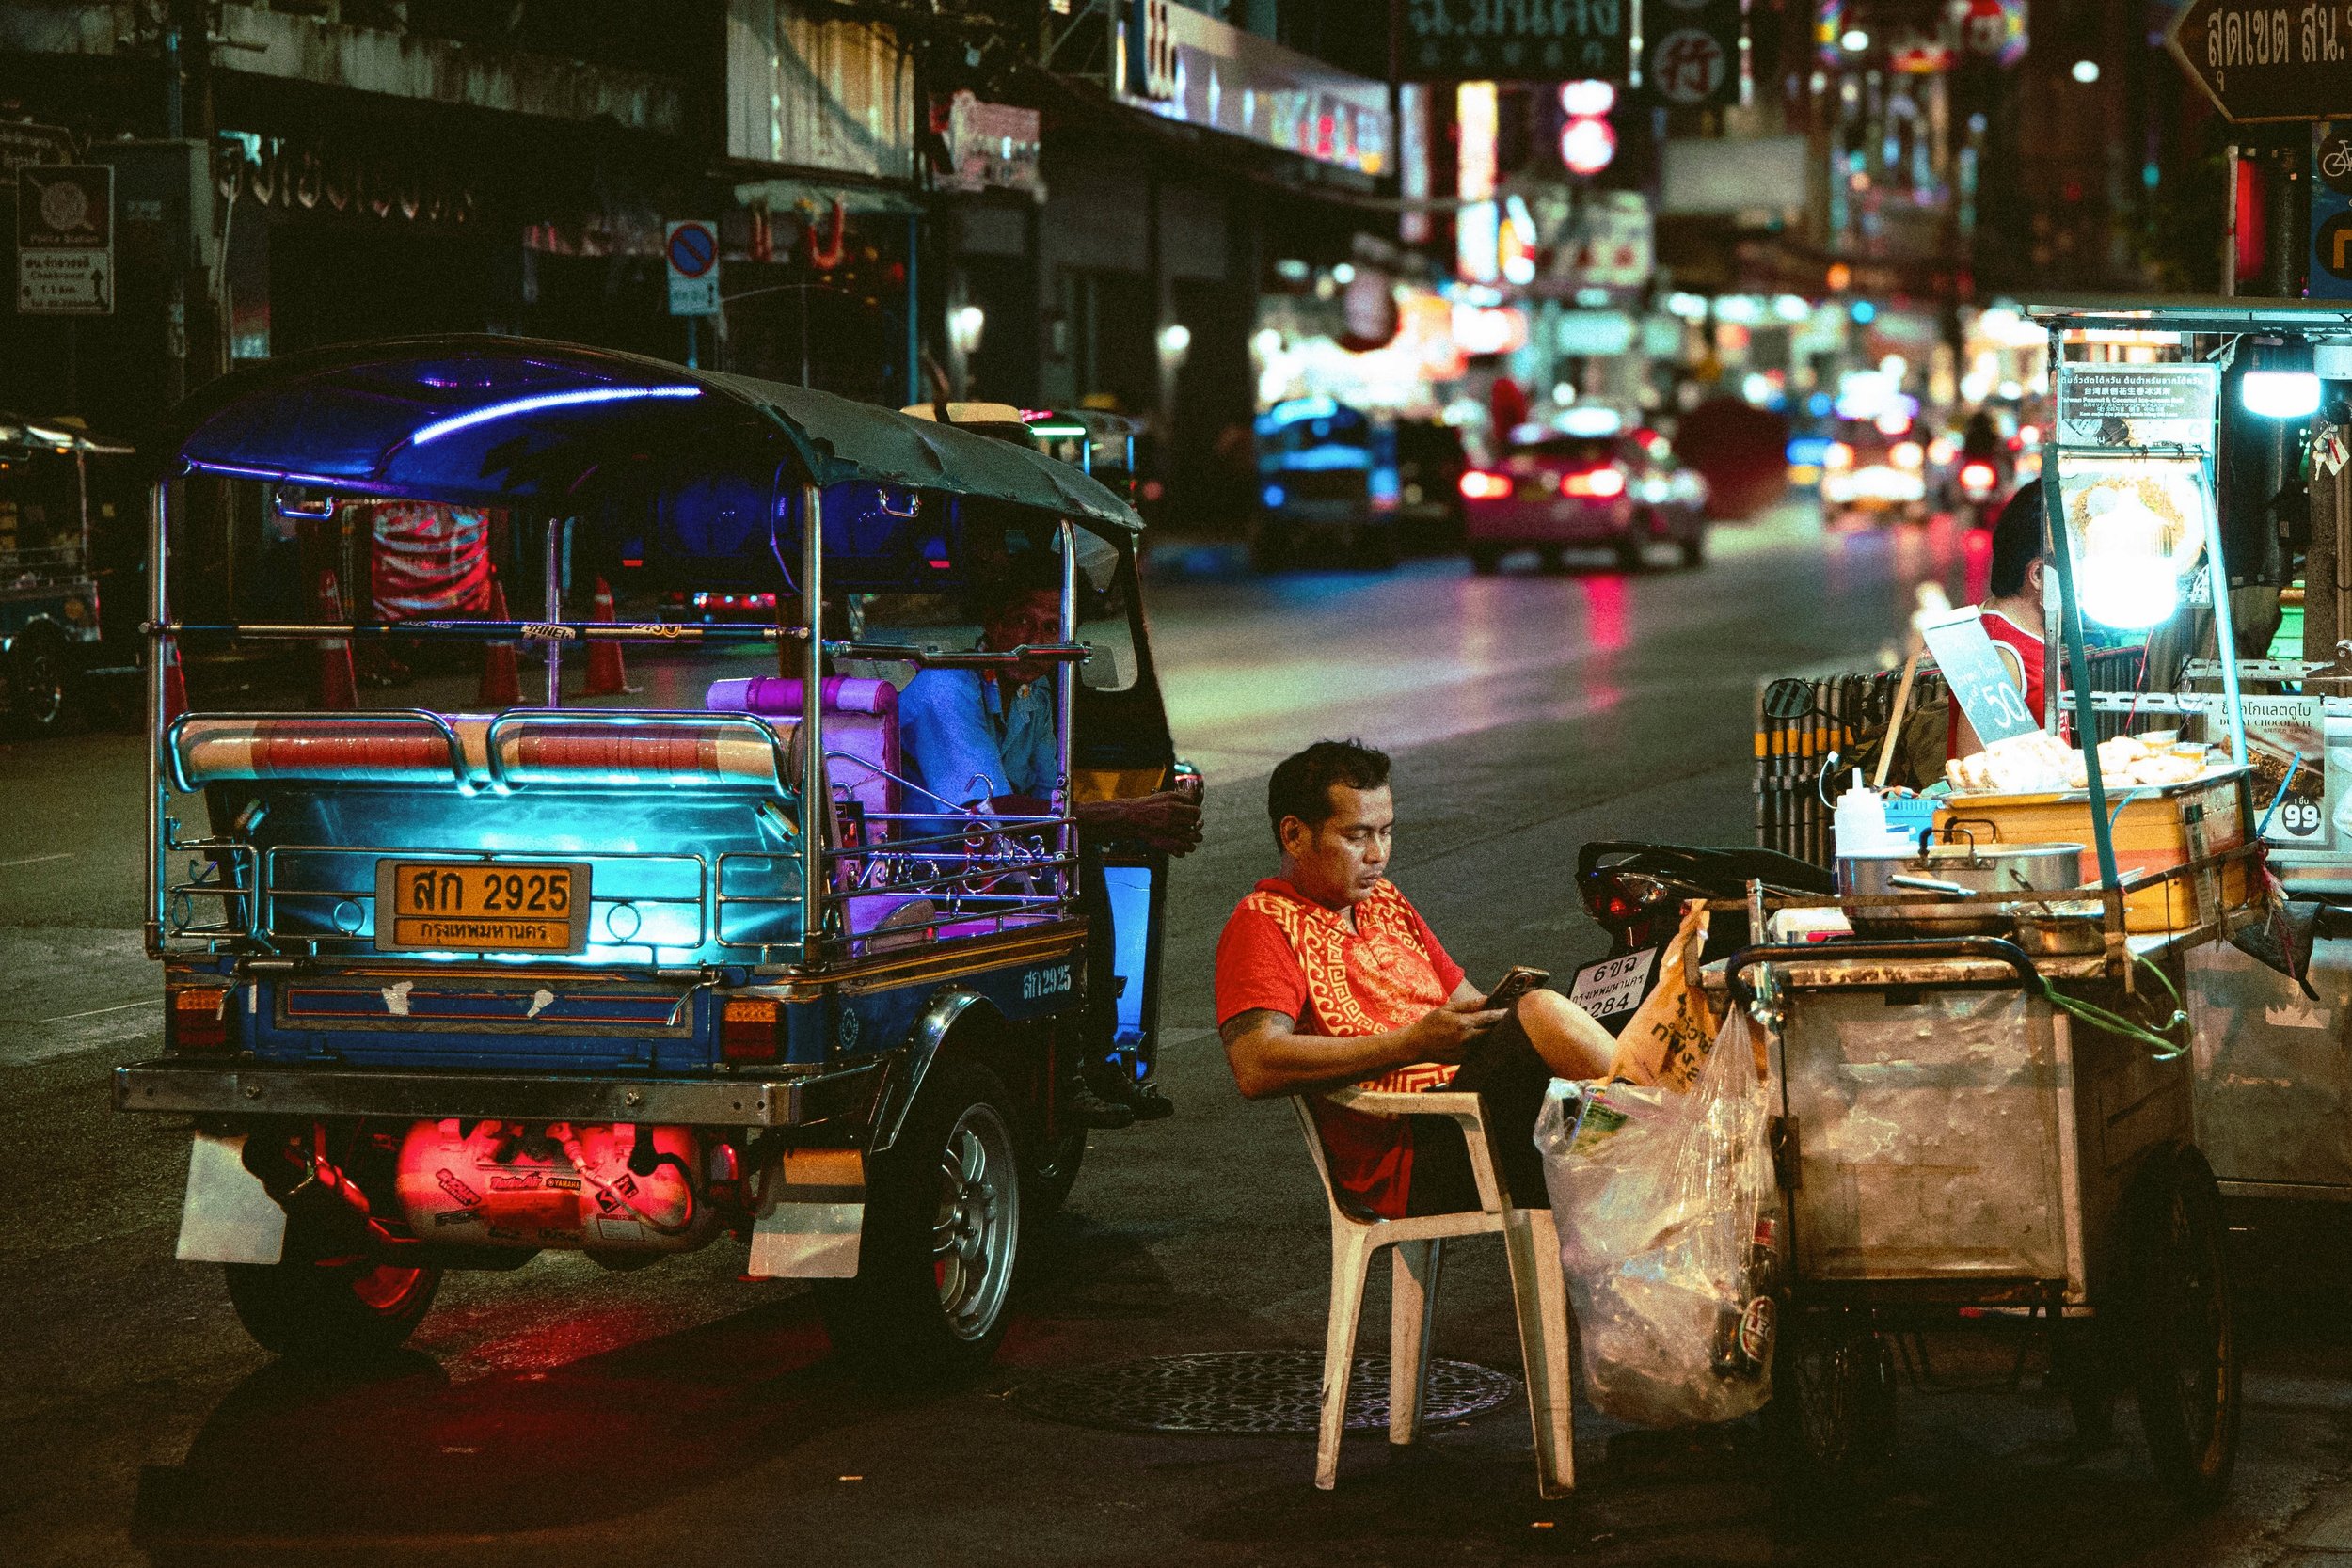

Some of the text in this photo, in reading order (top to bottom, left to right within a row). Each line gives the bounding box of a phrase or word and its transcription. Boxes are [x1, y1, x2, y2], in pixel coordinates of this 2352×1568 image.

[2207, 2, 2352, 92] สุดเขต สน.
[413, 869, 568, 911] สก 2925
[421, 922, 548, 944] กรุงเทพมหานคร
[1023, 964, 1072, 1000] สก 2925
[1581, 992, 1630, 1018] 284
[554, 1180, 580, 1189] YAMAHA
